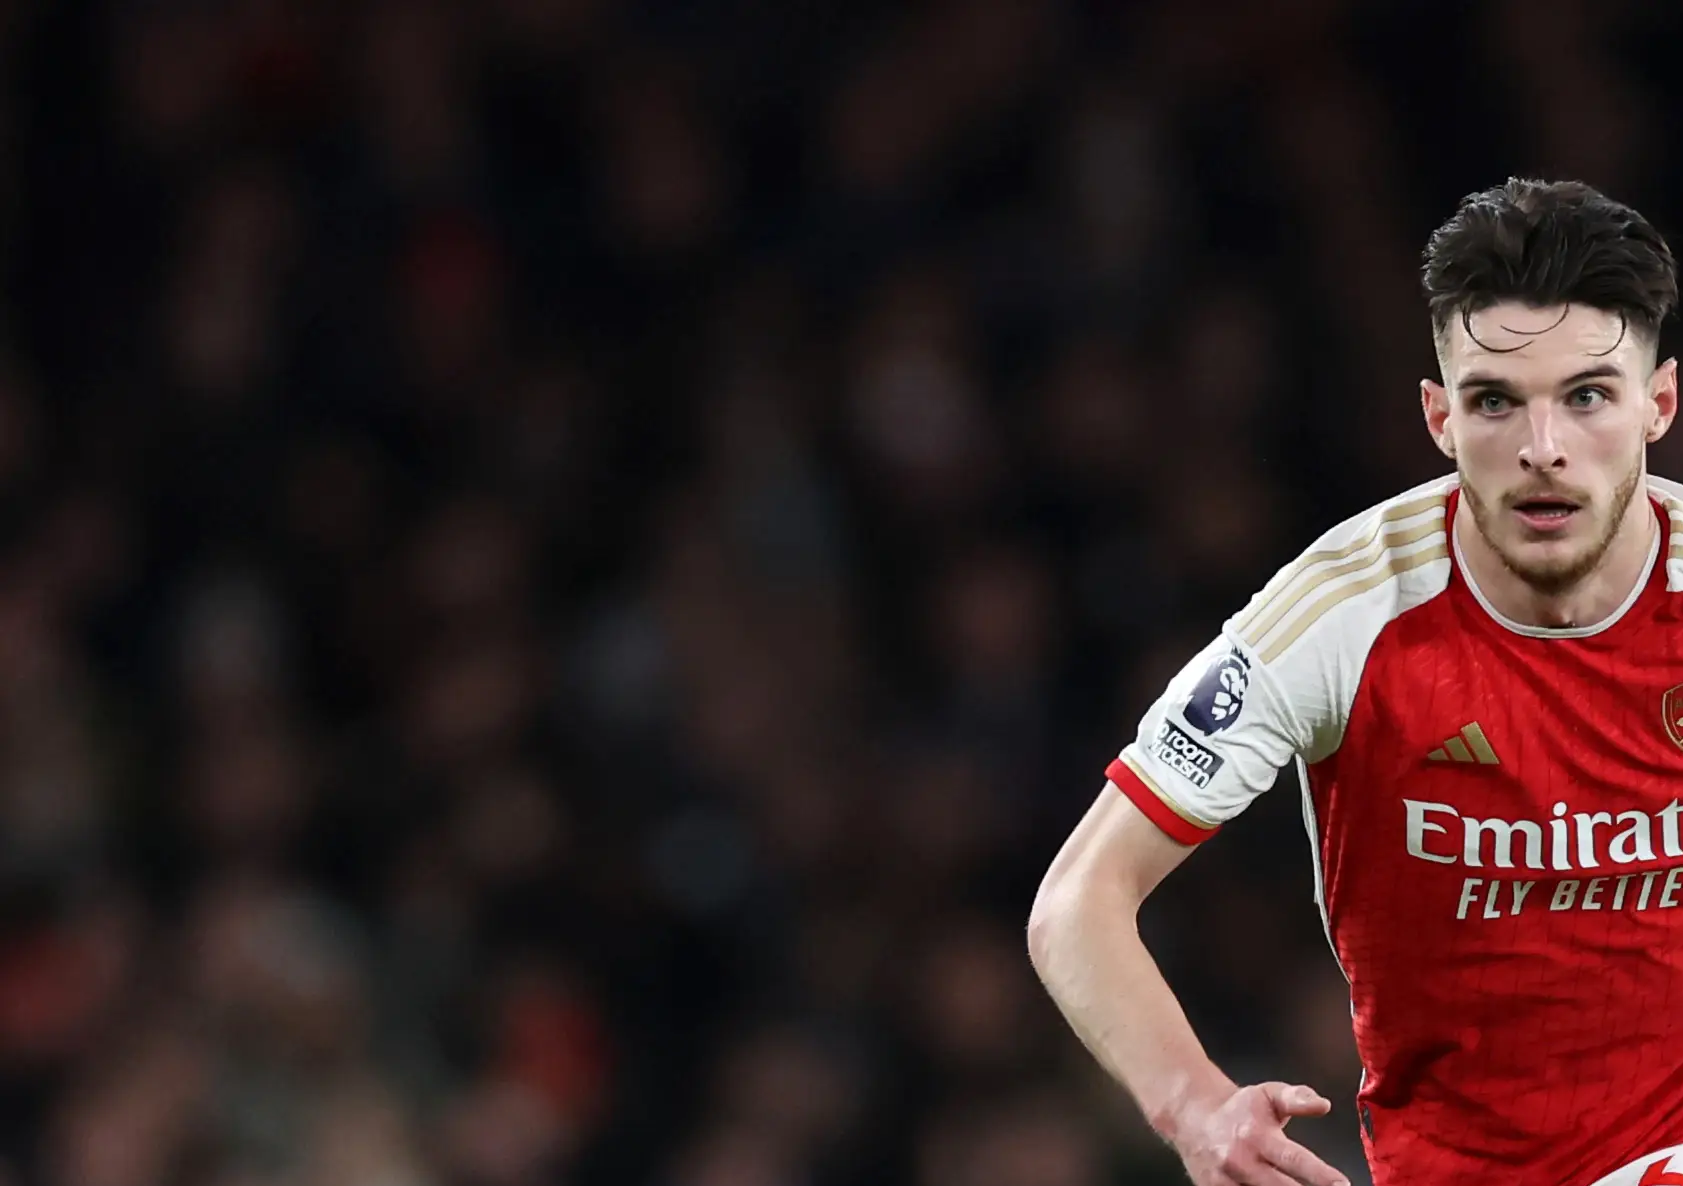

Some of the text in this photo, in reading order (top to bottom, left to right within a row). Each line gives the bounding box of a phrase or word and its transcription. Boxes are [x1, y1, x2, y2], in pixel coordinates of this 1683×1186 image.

[1158, 743, 1210, 789] racism
[1166, 729, 1214, 770] room
[1456, 877, 1535, 920] FLY
